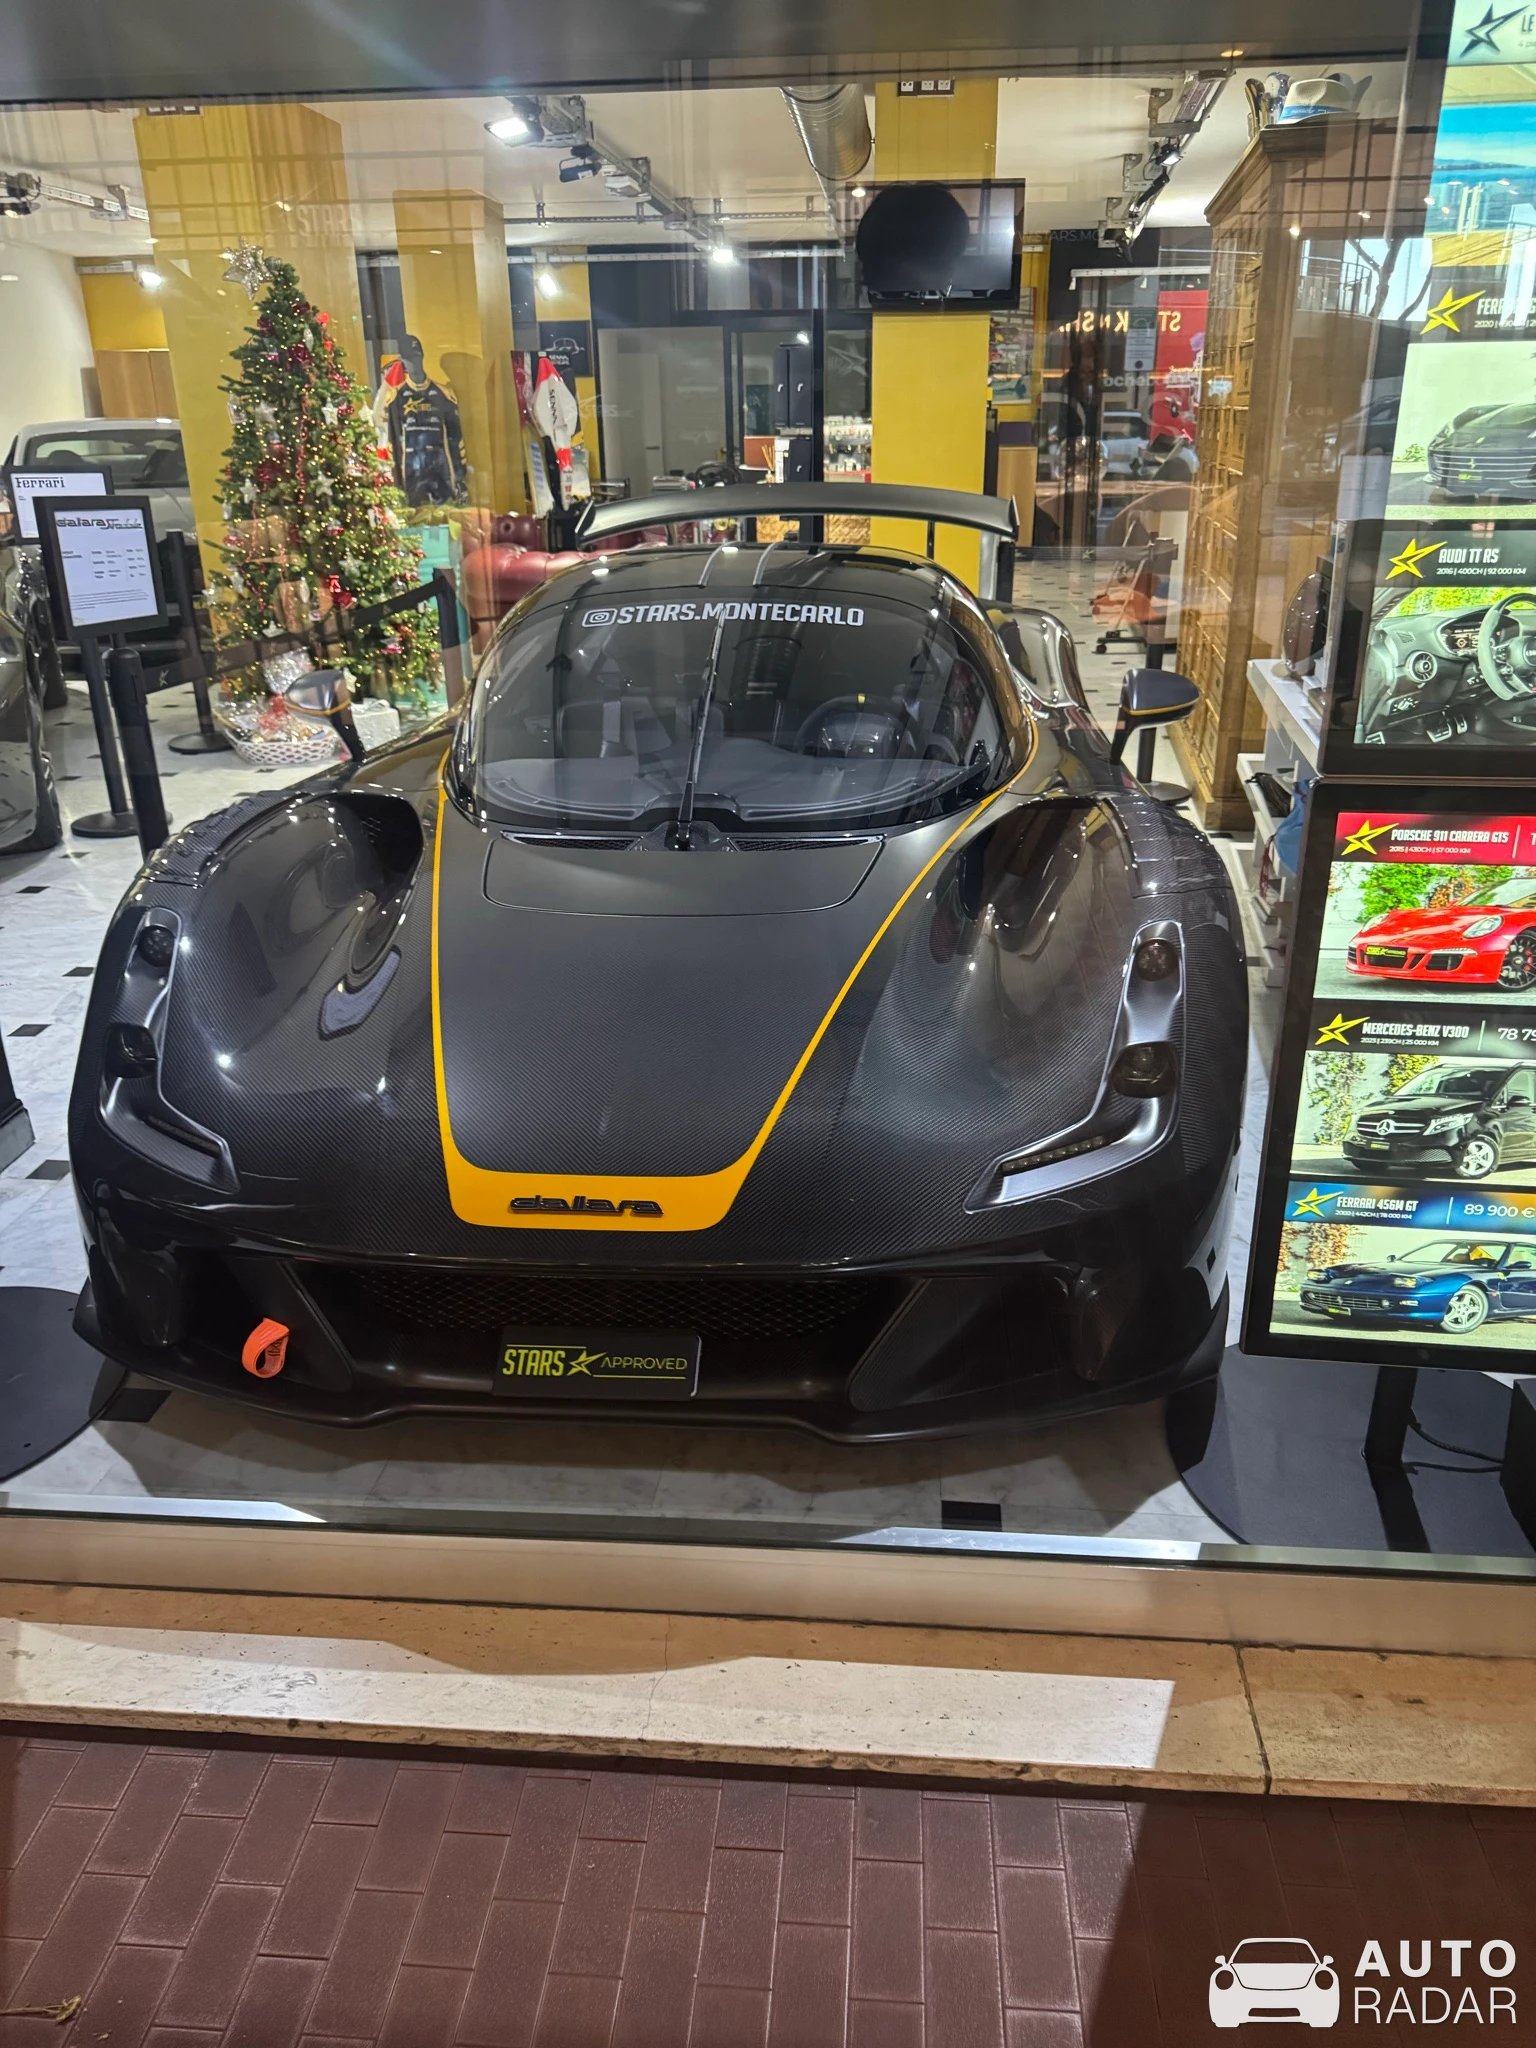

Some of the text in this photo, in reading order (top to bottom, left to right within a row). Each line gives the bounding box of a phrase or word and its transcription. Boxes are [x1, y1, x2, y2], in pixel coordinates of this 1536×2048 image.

[15, 477, 65, 489] Ferrari
[1438, 548, 1499, 563] AUDI TT RS
[1487, 567, 1497, 575] 92
[616, 602, 865, 627] STARS.MONTECARLO
[1391, 829, 1432, 842] PORSCHE
[1433, 829, 1448, 842] 911
[1449, 830, 1490, 843] CARRERA
[1491, 831, 1509, 844] GTS
[1362, 1022, 1441, 1038] MERCEDES-BENZ
[1442, 1025, 1470, 1039] V300
[1497, 1027, 1518, 1040] 78
[1336, 1197, 1536, 1219] FERRARI 456M GT 89 900 €
[502, 1349, 688, 1377] STARS APPROVED
